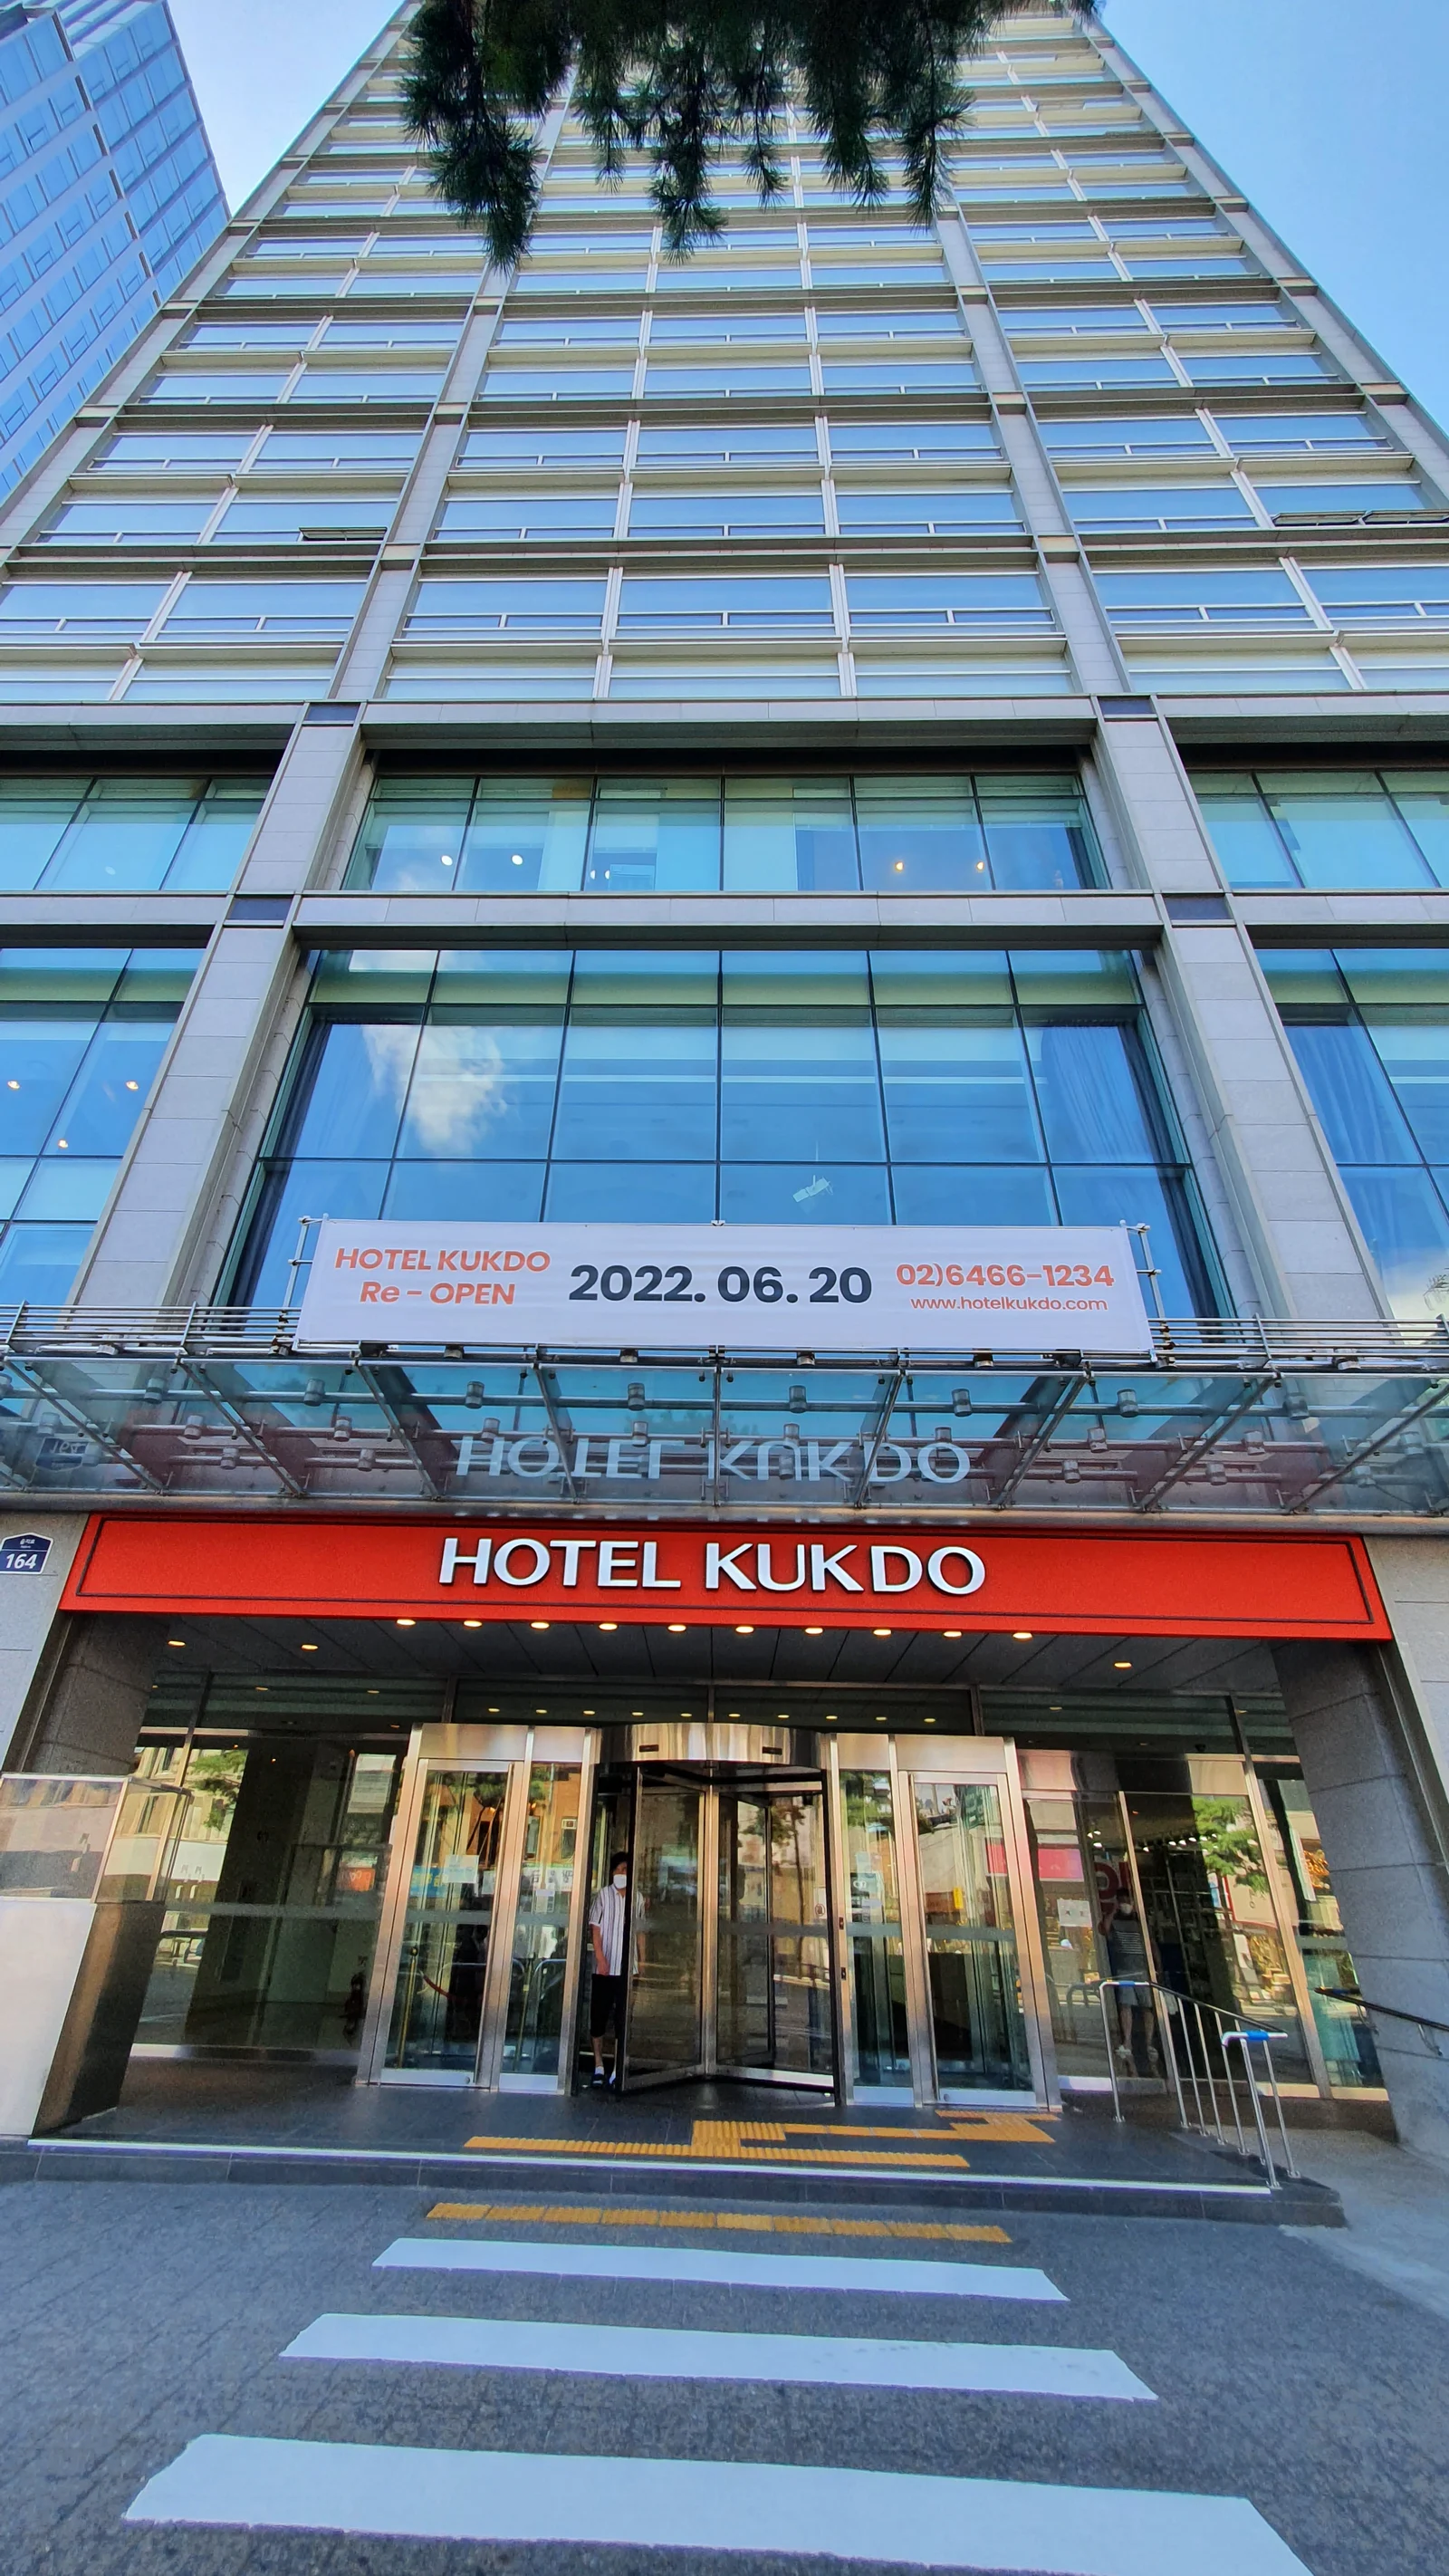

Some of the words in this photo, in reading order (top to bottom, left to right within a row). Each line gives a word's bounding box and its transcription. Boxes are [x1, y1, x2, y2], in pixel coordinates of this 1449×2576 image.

[334, 1247, 432, 1270] HOTEL
[437, 1250, 551, 1272] KUKDO
[568, 1264, 706, 1302] 2022.
[717, 1265, 799, 1303] 06.
[808, 1266, 872, 1303] 20
[896, 1263, 1115, 1287] 02)6466-1234
[360, 1282, 399, 1302] Re
[429, 1283, 515, 1304] OPEN
[910, 1296, 1108, 1311] www.hotelkukdo.com
[6, 1552, 37, 1569] 164
[438, 1538, 681, 1589] HOTEL
[705, 1543, 986, 1595] KUKDO
